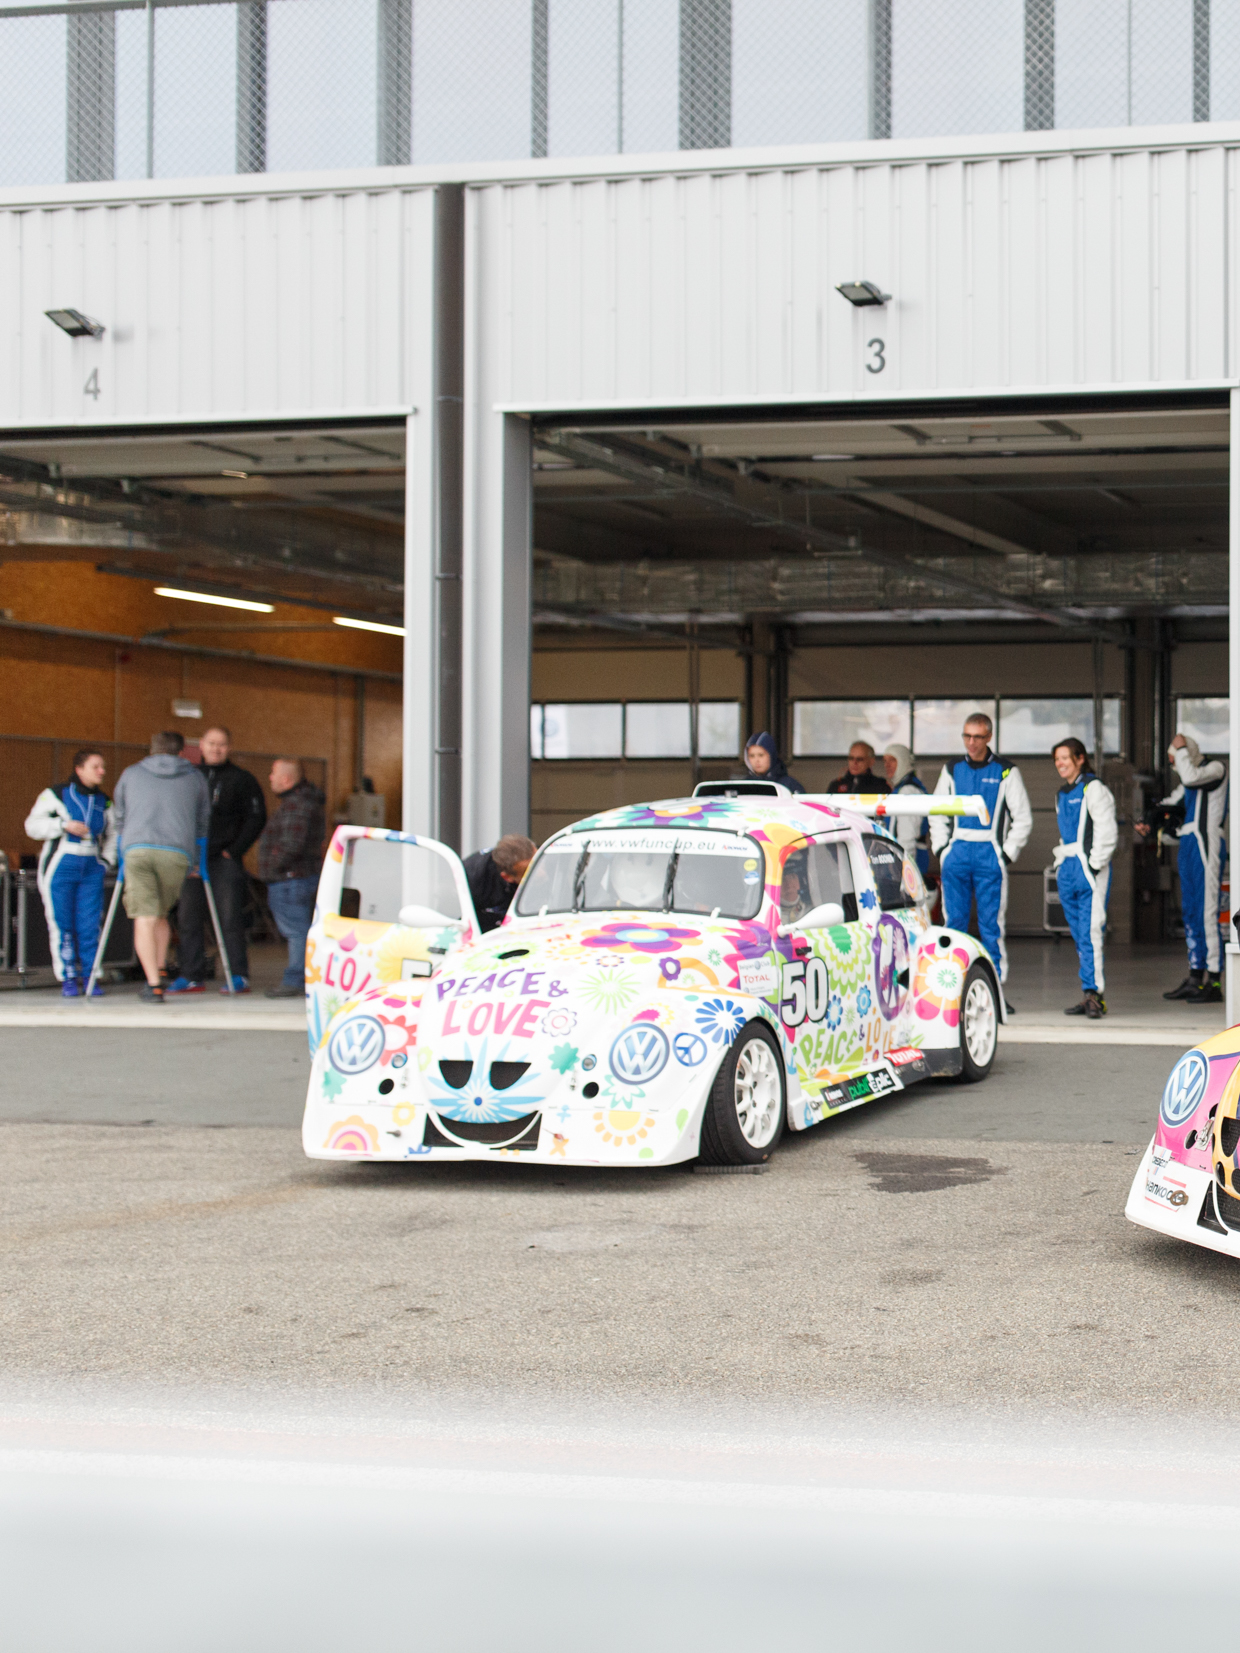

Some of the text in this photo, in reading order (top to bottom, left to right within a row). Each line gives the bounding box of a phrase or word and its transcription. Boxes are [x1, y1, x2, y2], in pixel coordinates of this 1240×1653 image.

[865, 338, 886, 374] 3
[83, 367, 102, 400] 4
[436, 967, 546, 1002] PEACE
[547, 980, 569, 997] &
[781, 956, 829, 1028] 50
[441, 999, 552, 1039] LOVE
[799, 1028, 858, 1067] PEACE
